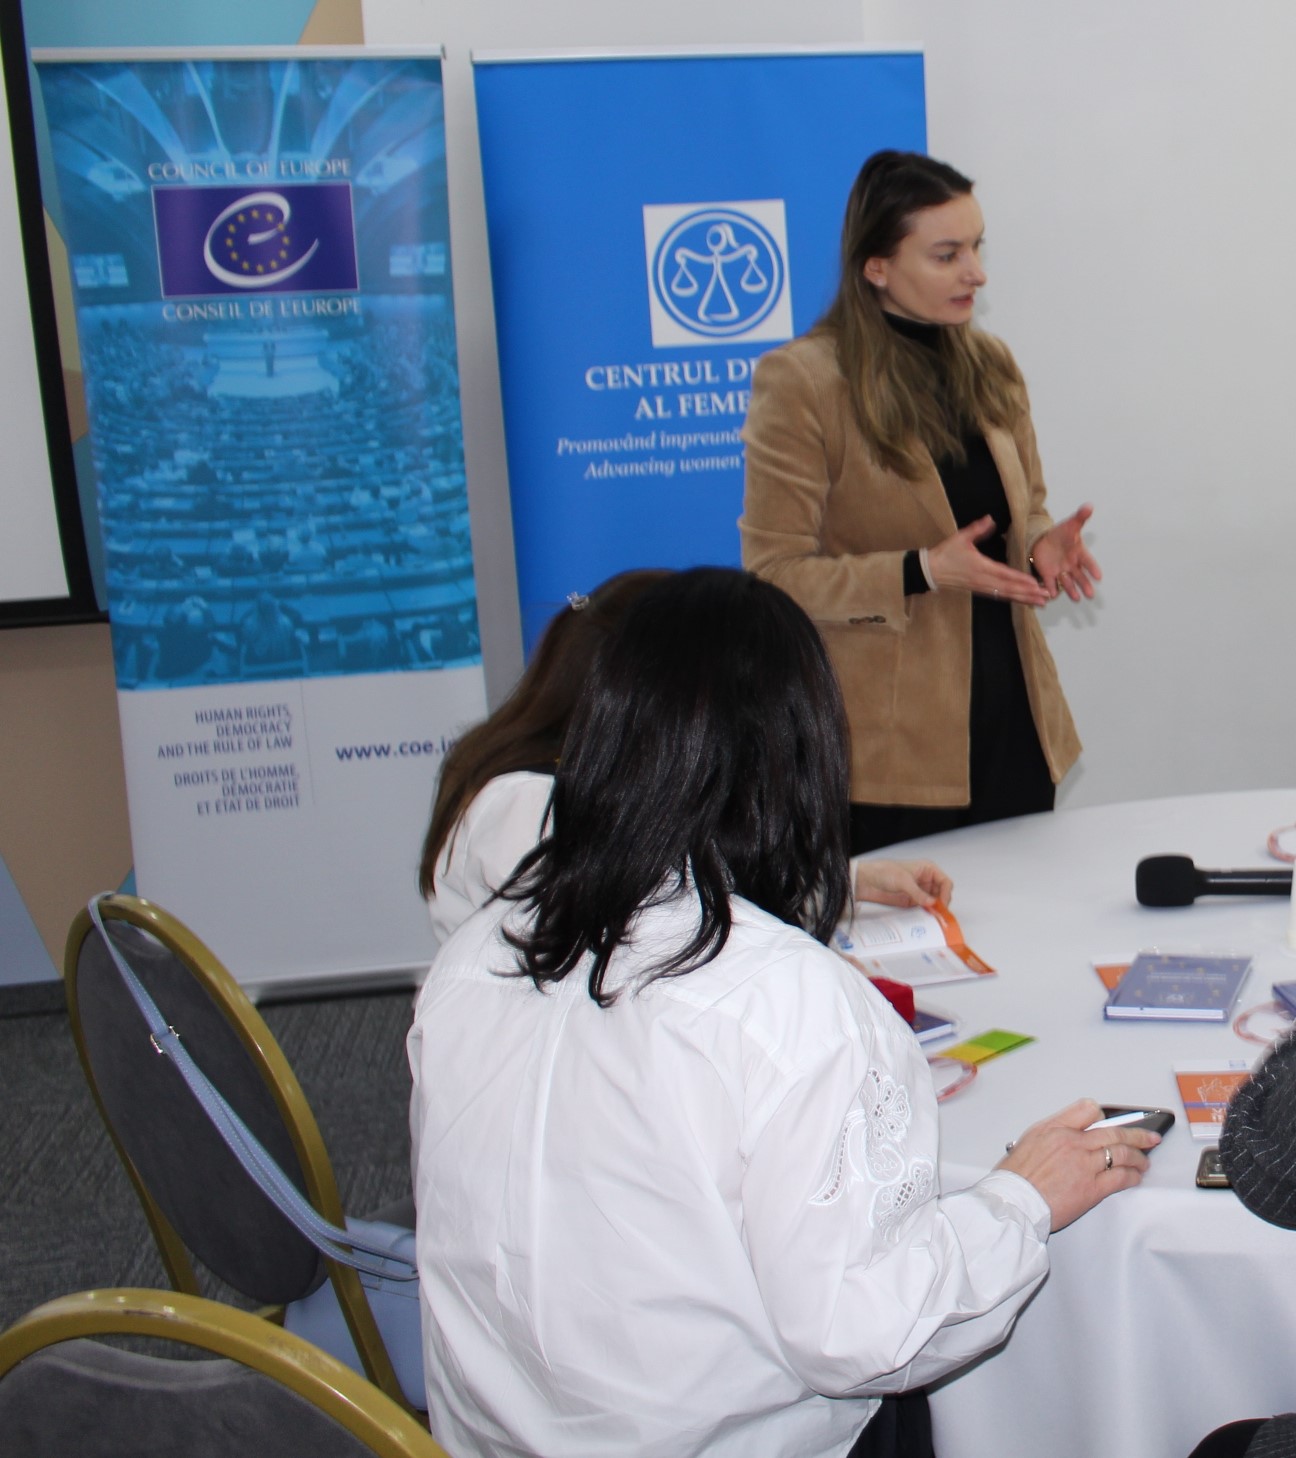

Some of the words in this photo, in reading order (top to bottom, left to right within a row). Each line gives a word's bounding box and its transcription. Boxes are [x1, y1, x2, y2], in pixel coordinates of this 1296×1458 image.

[147, 161, 238, 182] COUNCIL
[246, 160, 272, 178] OF
[279, 158, 350, 178] EUROPE
[162, 302, 246, 322] CONSEIL
[249, 300, 273, 319] DE
[279, 297, 361, 317] L'EUROPE
[585, 360, 720, 391] CENTRUL
[634, 394, 672, 421] AL
[556, 430, 656, 457] Promovând
[584, 456, 675, 481] Advancing
[195, 706, 243, 725] HUMAN
[215, 720, 292, 738] DEMOCRACY
[157, 743, 184, 760] AND
[186, 741, 209, 757] THE
[213, 738, 243, 755] RULE
[246, 737, 263, 752] OF
[266, 735, 293, 750] LAW
[173, 769, 218, 789] DROITS
[221, 767, 236, 783] DE
[196, 800, 210, 817] ET
[245, 797, 261, 813] DE
[263, 793, 300, 811] DROIT
